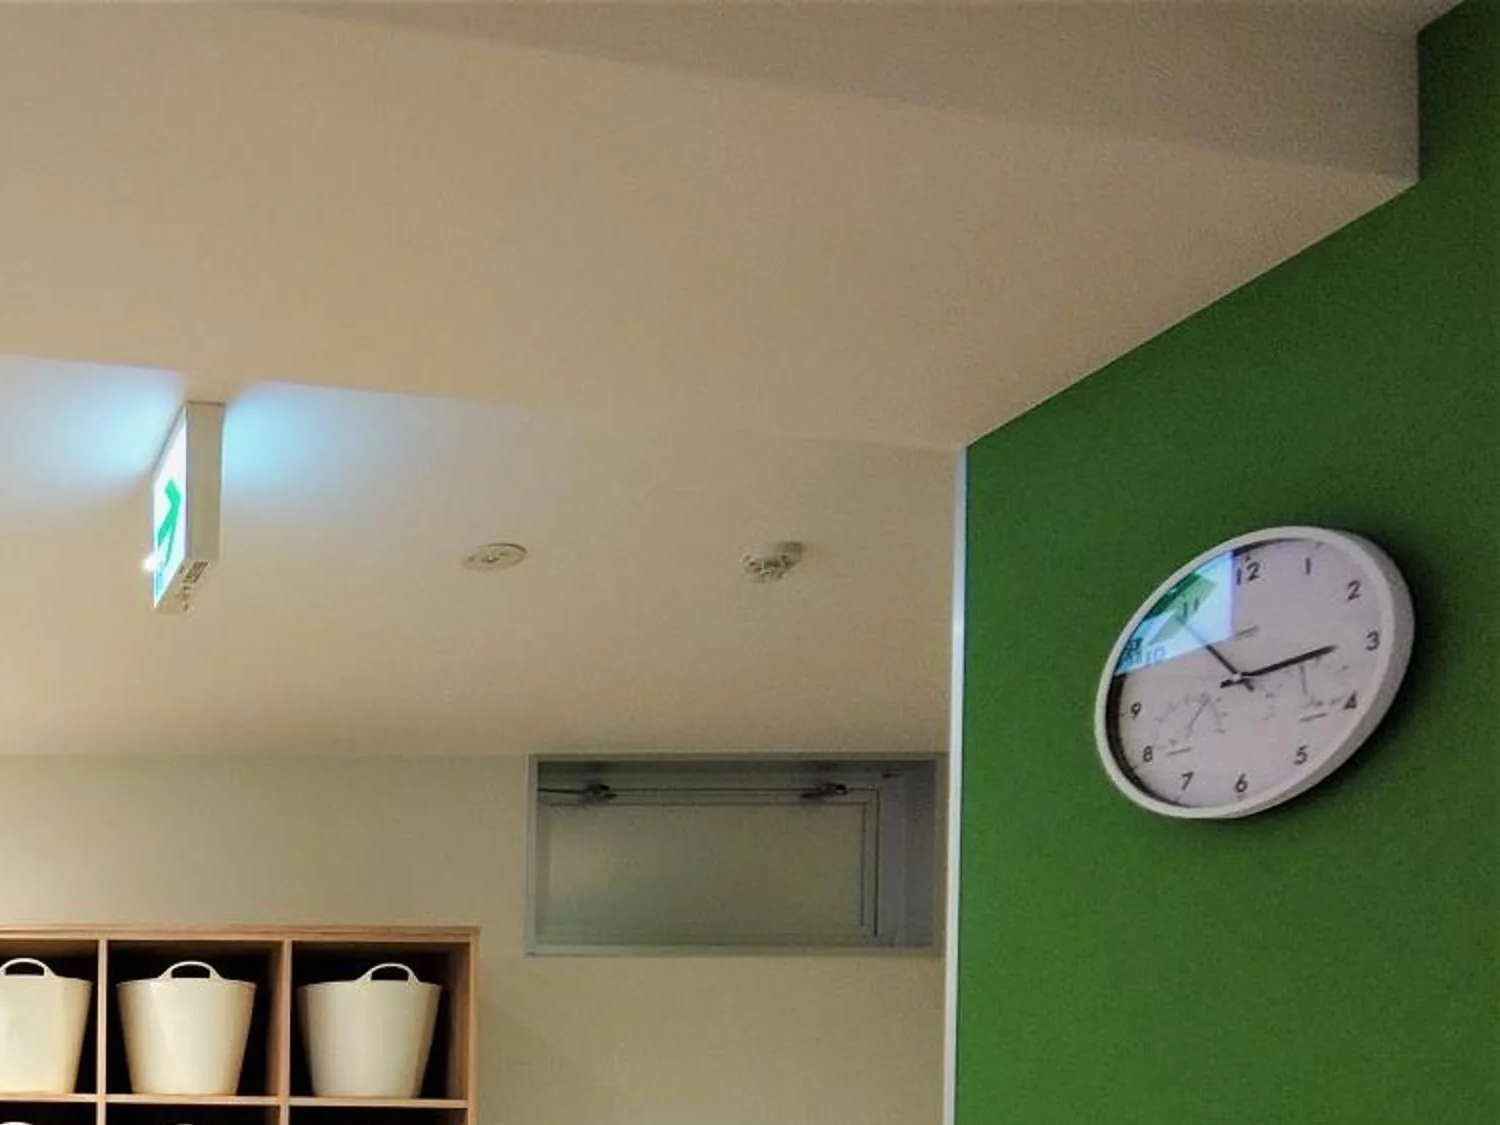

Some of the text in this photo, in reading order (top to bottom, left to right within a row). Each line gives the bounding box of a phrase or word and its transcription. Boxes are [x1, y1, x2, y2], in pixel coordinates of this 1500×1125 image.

[1236, 561, 1260, 585] 12
[1306, 557, 1312, 575] 1
[1346, 579, 1361, 600] 2
[1366, 631, 1381, 652] 3
[1130, 702, 1142, 719] 9
[1342, 691, 1358, 711] 4
[1142, 746, 1153, 763] 8
[1294, 746, 1309, 766] 5
[1181, 772, 1195, 791] 7
[1235, 773, 1248, 793] 6
